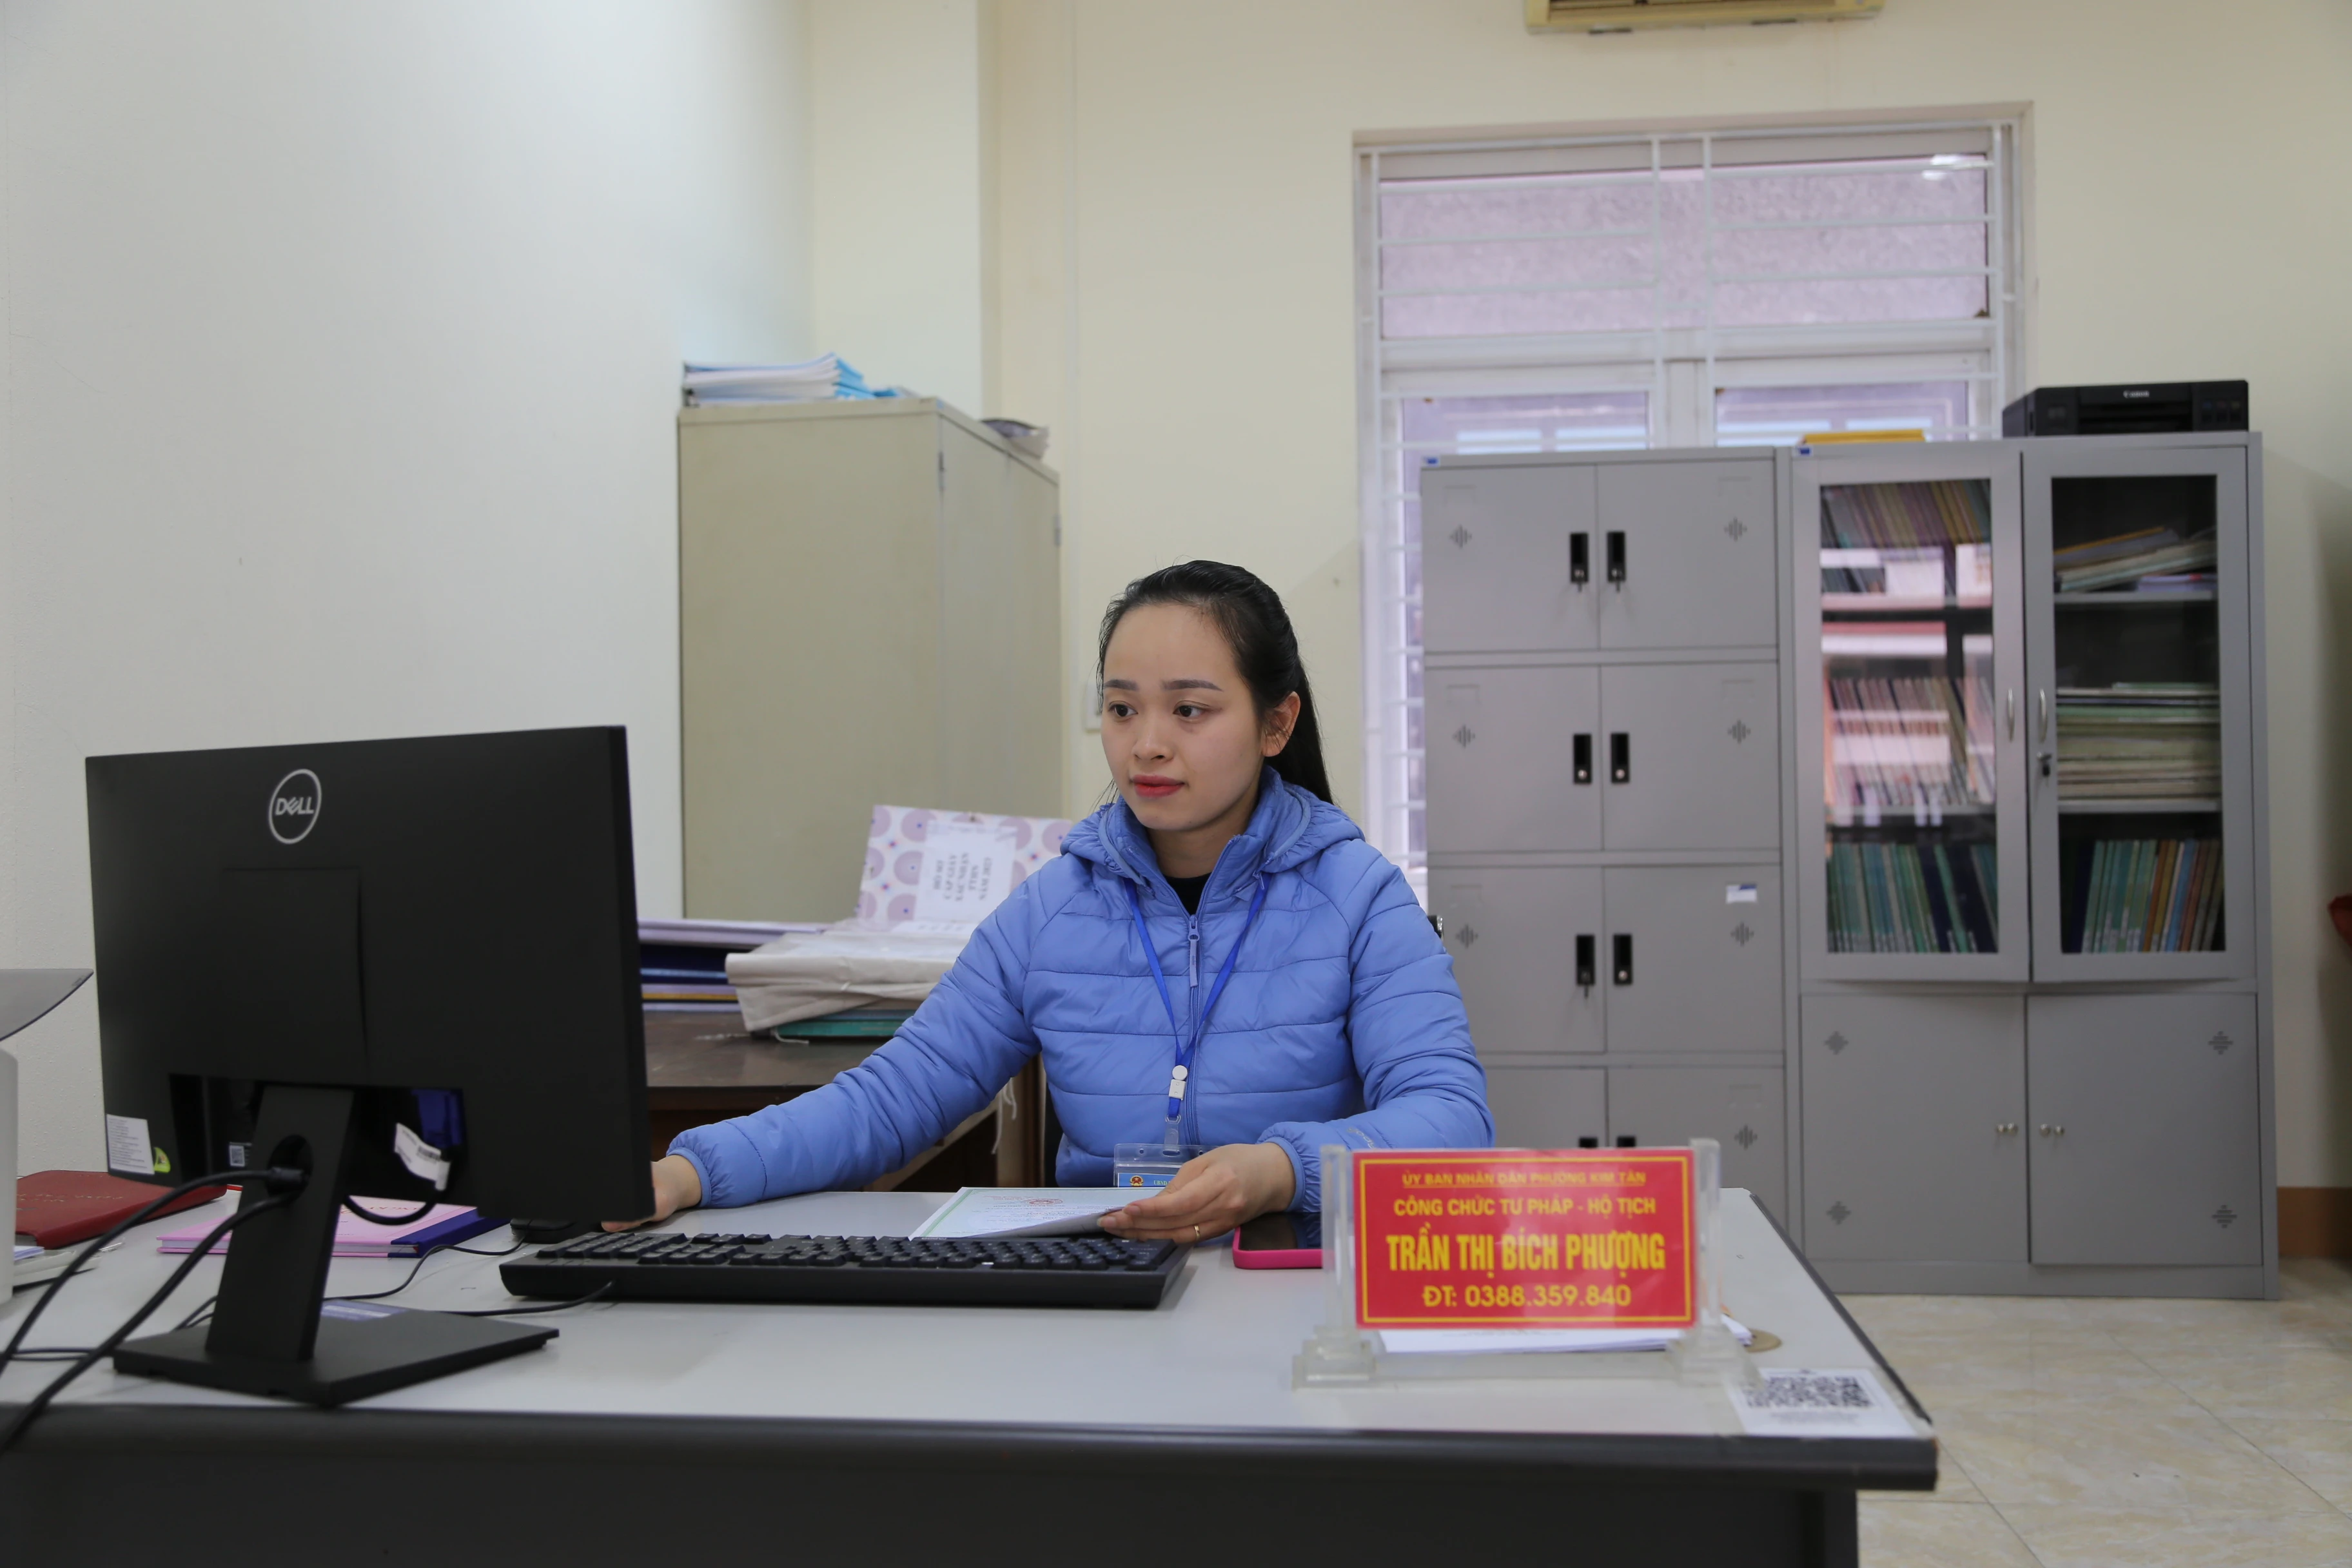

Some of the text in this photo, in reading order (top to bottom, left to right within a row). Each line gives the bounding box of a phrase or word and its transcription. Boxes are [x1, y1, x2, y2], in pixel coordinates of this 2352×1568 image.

[275, 797, 315, 816] DELL
[1425, 1173, 1453, 1184] BAN
[1591, 1172, 1614, 1182] KIM
[1393, 1195, 1444, 1216] CÔNG
[1447, 1194, 1496, 1216] CHỨC
[1500, 1197, 1524, 1215] TƯ
[1527, 1193, 1574, 1215] PHÁP
[1587, 1193, 1612, 1219] HỘ
[1616, 1197, 1656, 1219] TỊCH
[1386, 1221, 1665, 1279] TRẦN THỊ BÍCH PHƯỢNG
[1422, 1284, 1632, 1307] ĐT: 0388.359.840
